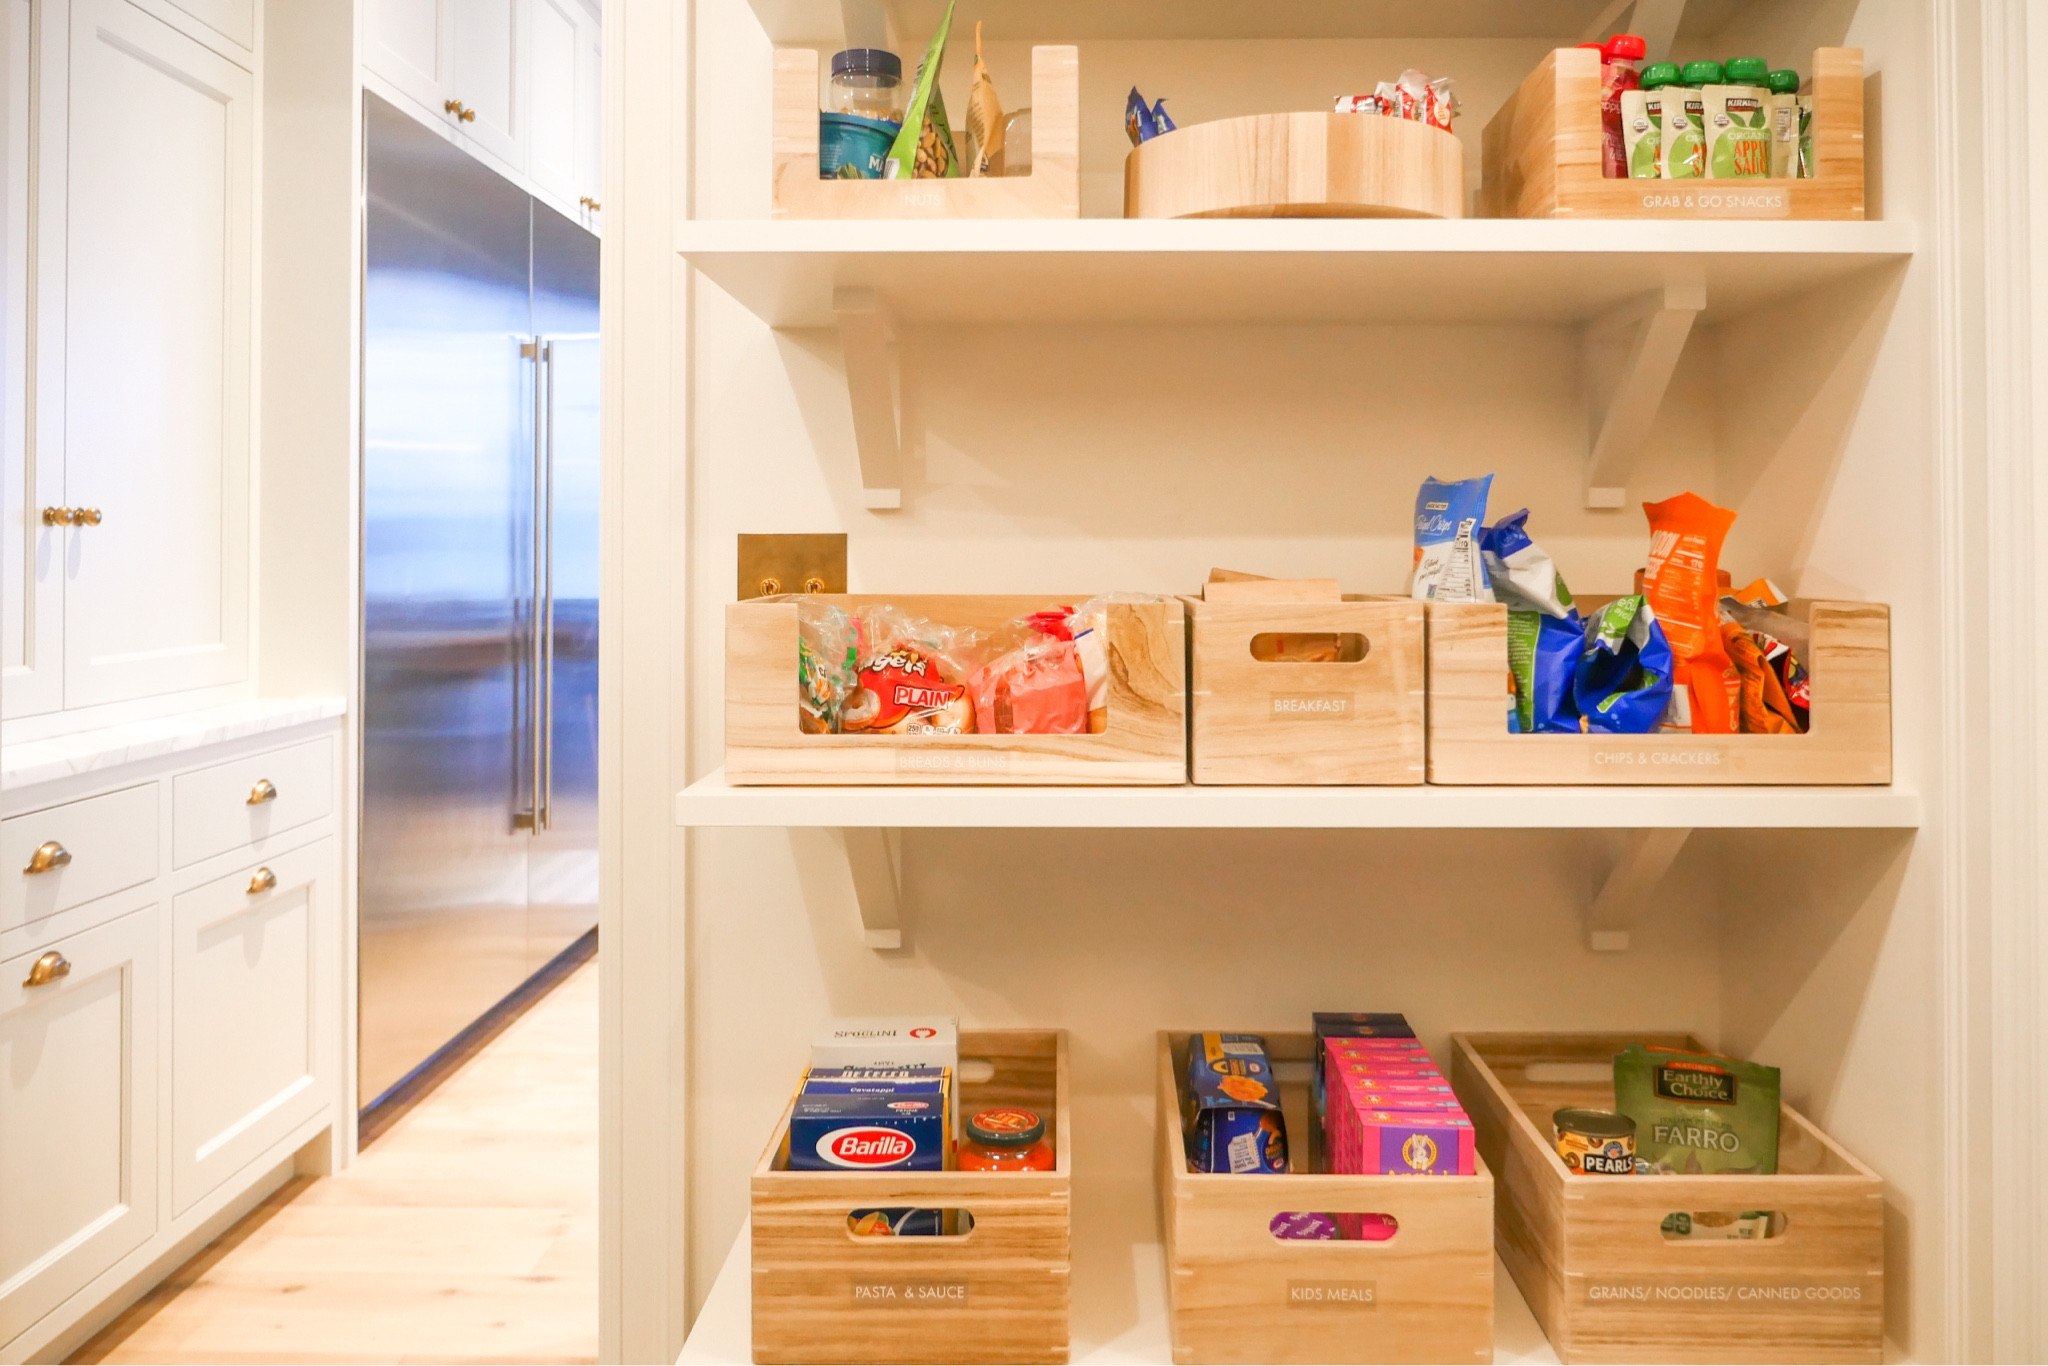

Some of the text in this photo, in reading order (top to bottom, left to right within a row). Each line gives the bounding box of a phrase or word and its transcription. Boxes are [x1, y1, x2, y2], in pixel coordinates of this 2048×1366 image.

[905, 194, 941, 206] NUTS
[1643, 196, 1782, 208] GRAB & GO SNACKS
[895, 687, 949, 708] PLAIN
[1274, 700, 1347, 712] BREAKFAST
[900, 755, 1007, 768] BREADS & BUNS
[1594, 753, 1721, 765] CHIPS & CRACKERS
[1663, 1069, 1723, 1089] Earthly
[1670, 1082, 1728, 1100] Choice
[839, 1136, 907, 1156] Barilla
[1653, 1126, 1740, 1153] FARRO
[1585, 1156, 1633, 1173] PEARLS
[855, 1286, 965, 1299] PASTA & SAUCE
[1291, 1288, 1373, 1301] KIDS MEALS
[1589, 1286, 1861, 1301] GRAINS/ NOODLES/ CANNED GOODS
